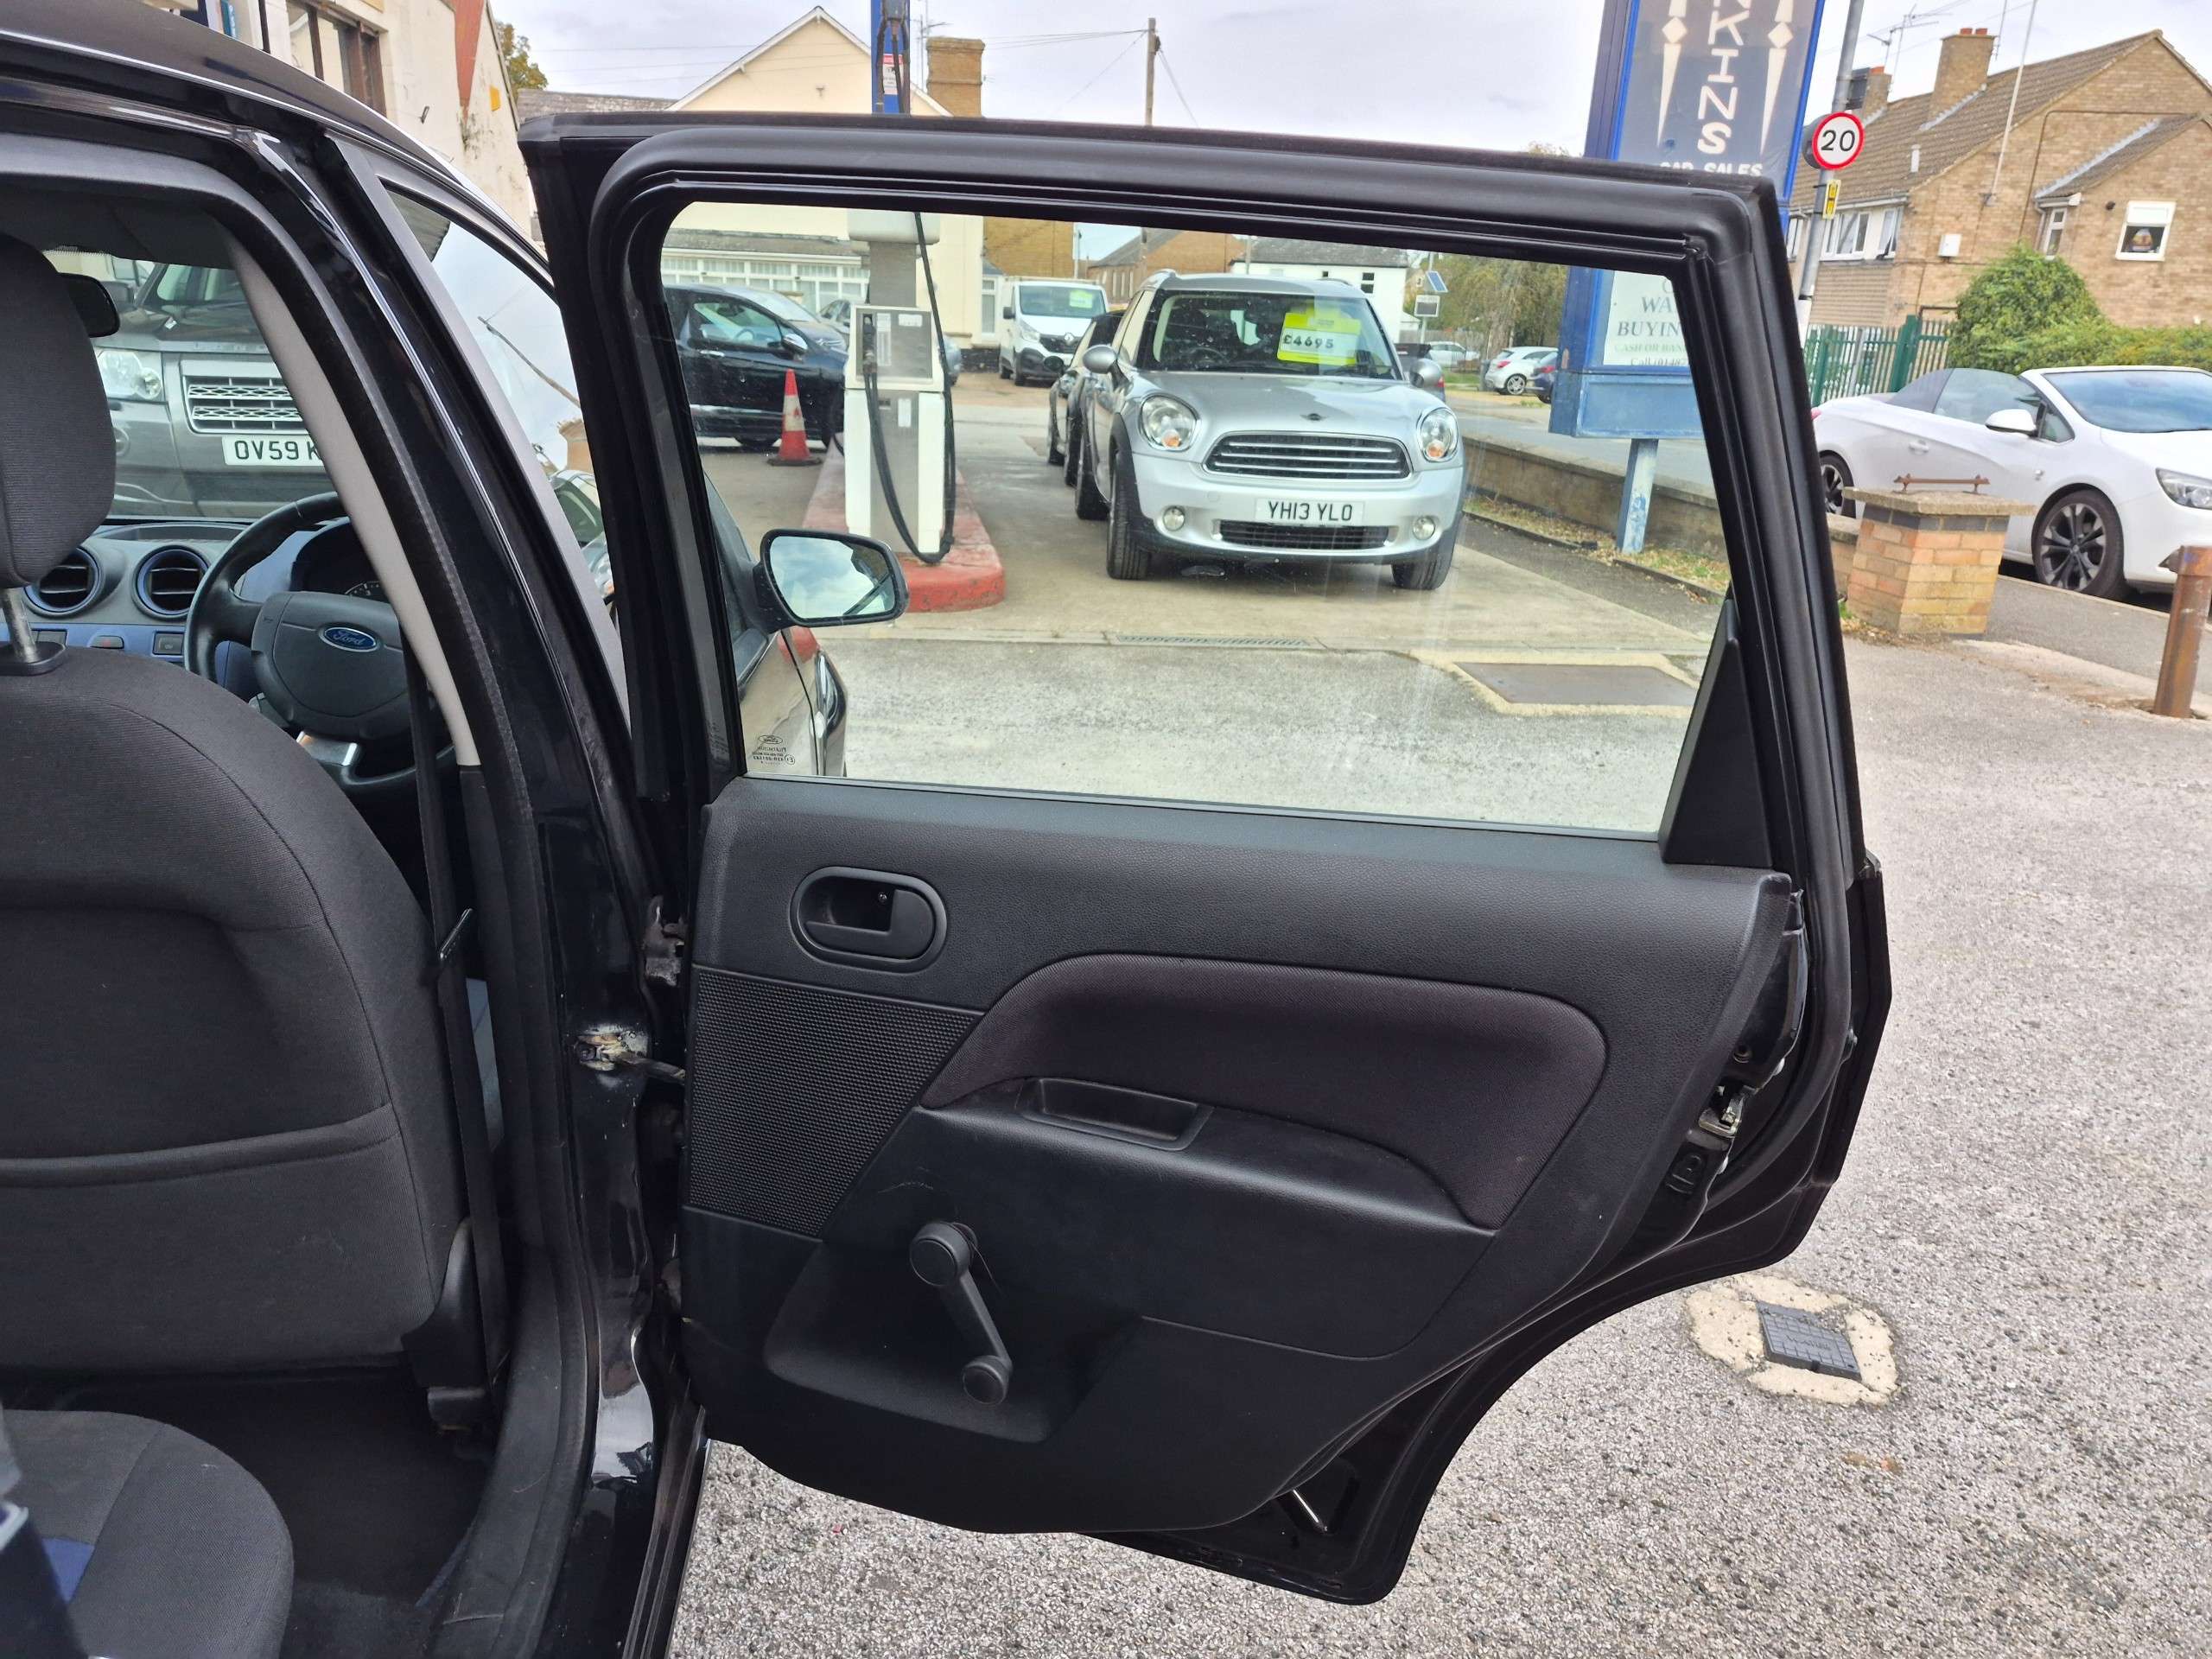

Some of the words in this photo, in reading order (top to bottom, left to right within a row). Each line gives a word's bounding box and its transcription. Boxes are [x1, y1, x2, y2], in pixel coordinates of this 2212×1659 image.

[1697, 0, 1751, 155] KINS
[1821, 130, 1856, 152] 20
[1642, 296, 1674, 313] WA
[1618, 321, 1681, 337] BUYIN
[1282, 334, 1334, 349] £4695
[234, 440, 299, 461] OV59
[1268, 500, 1310, 520] YH13
[1318, 503, 1353, 521] YLO
[332, 630, 365, 645] Ford
